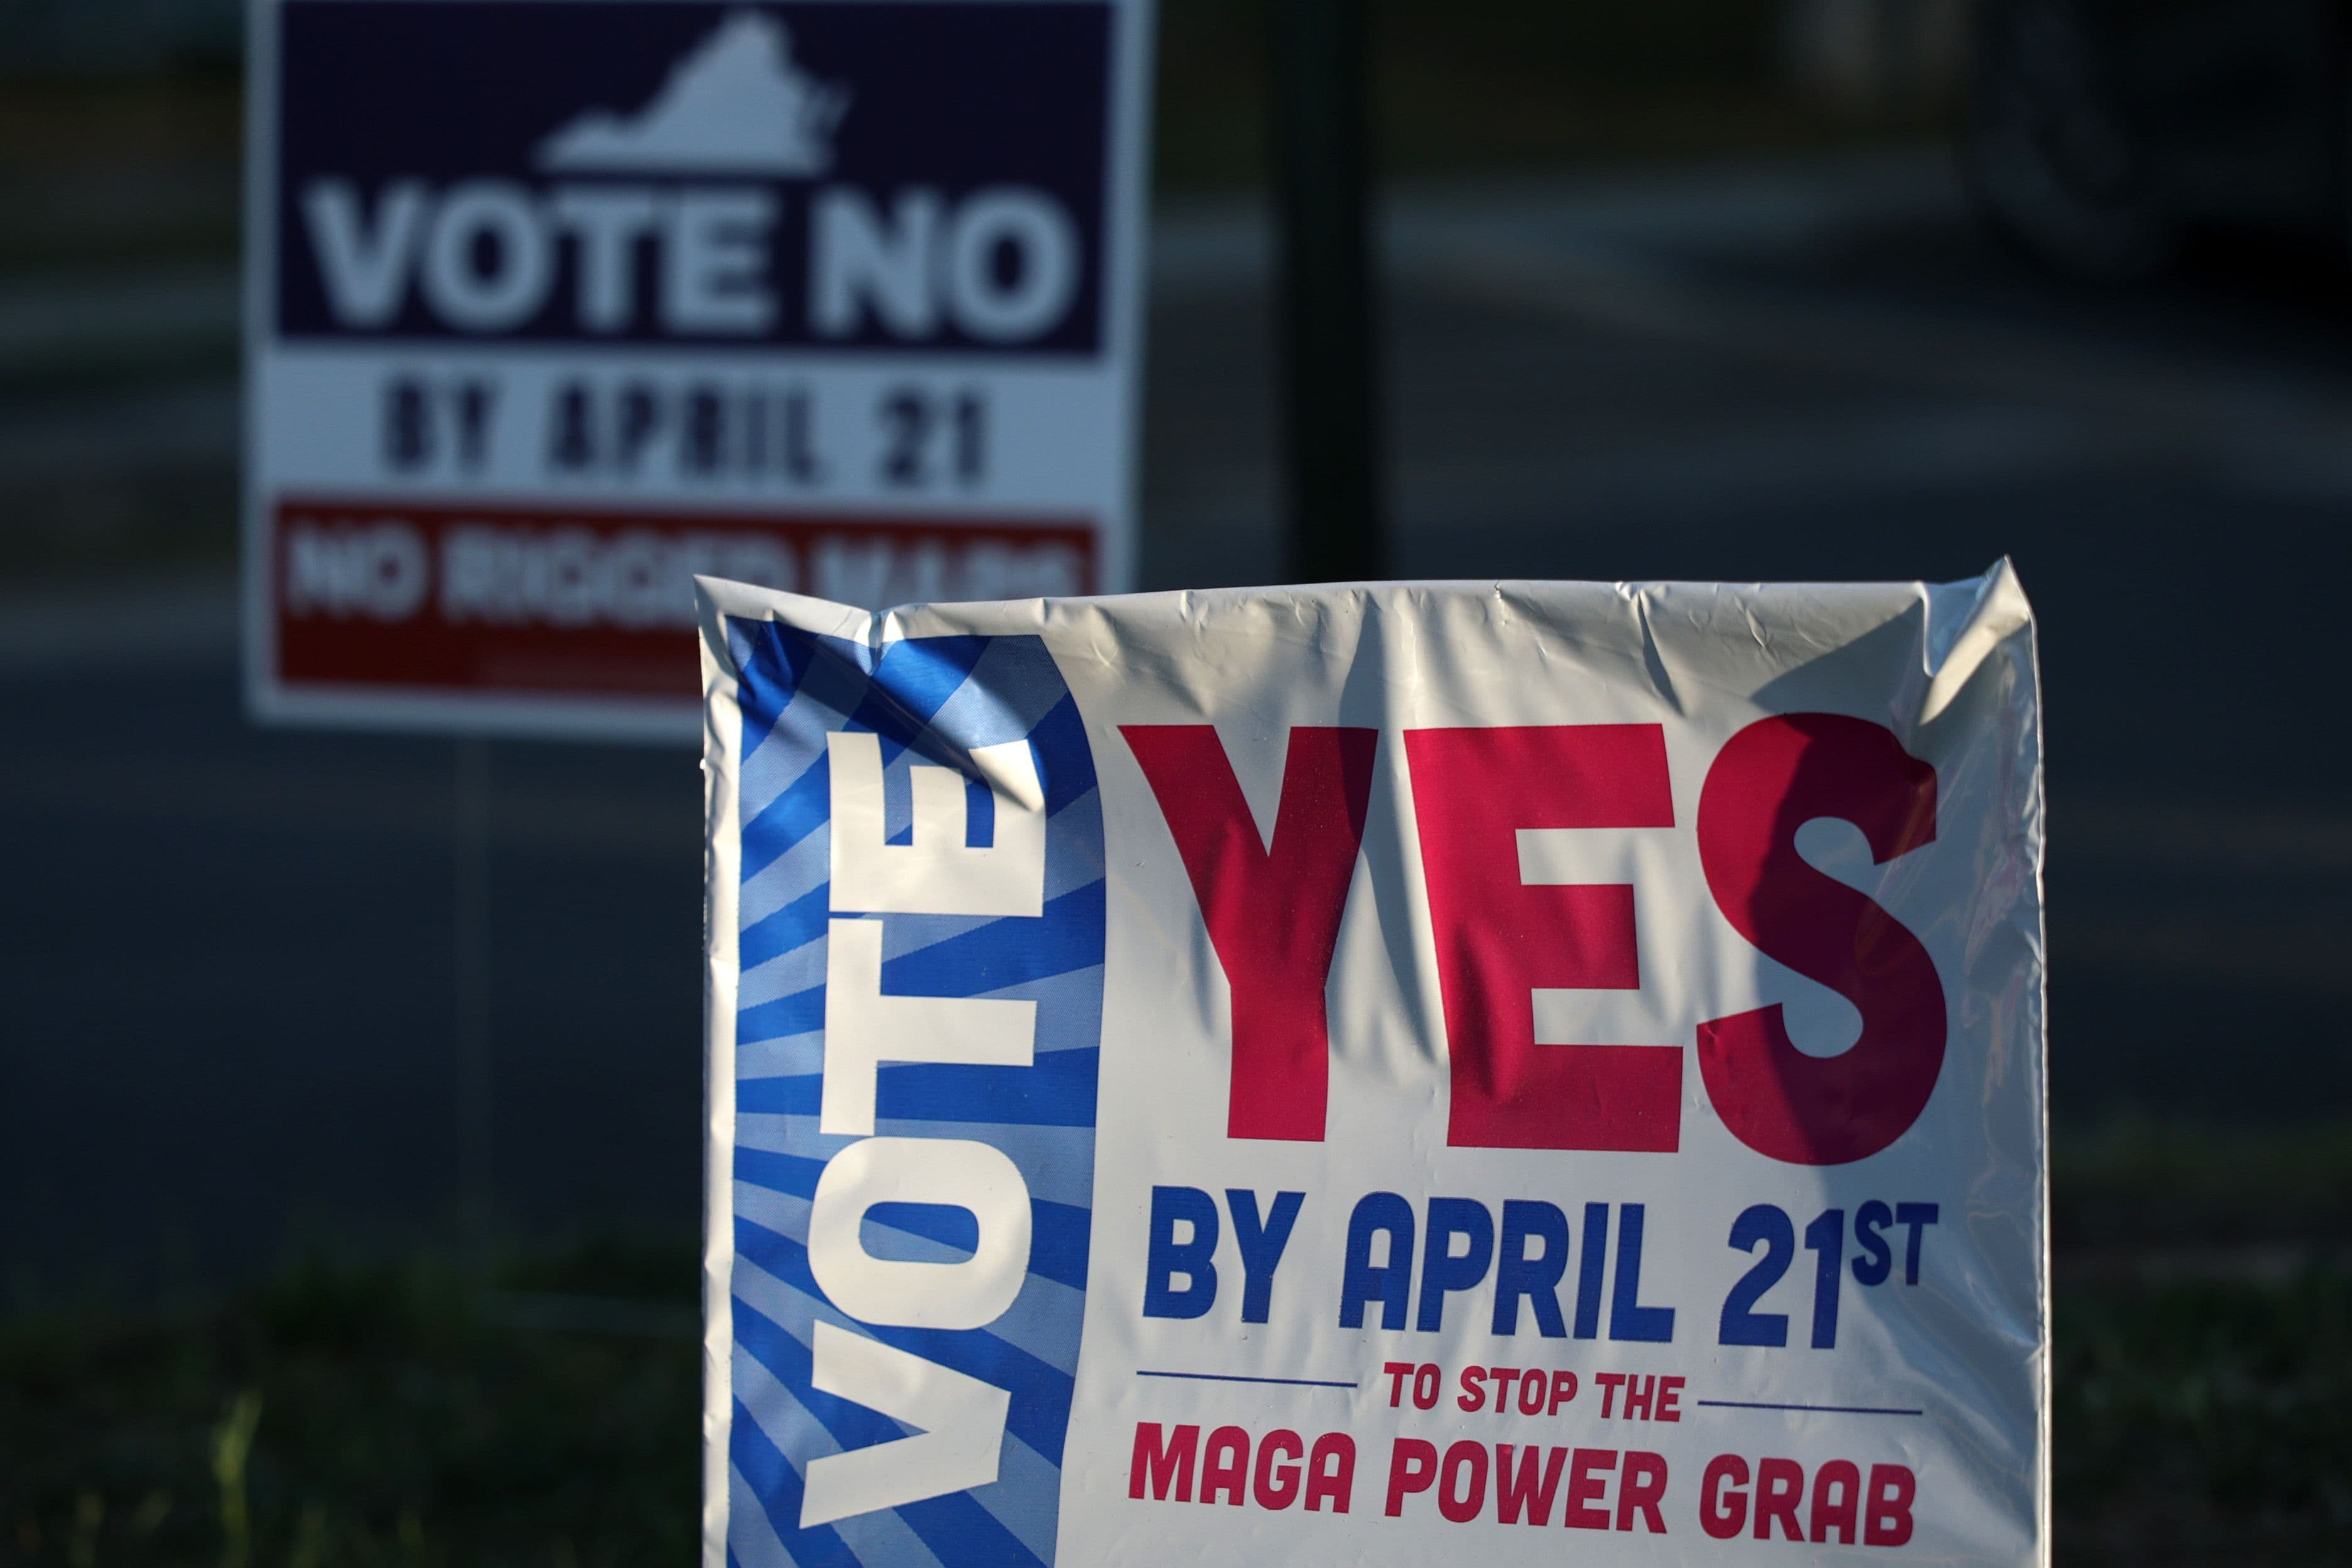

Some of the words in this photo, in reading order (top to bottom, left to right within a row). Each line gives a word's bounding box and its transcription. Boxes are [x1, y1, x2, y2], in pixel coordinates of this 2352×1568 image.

[303, 178, 776, 333] VOTE
[809, 187, 1079, 342] NO
[382, 377, 496, 475] BY
[545, 382, 824, 487] APRIL
[876, 391, 993, 489] 21
[286, 523, 430, 619] NO
[438, 526, 797, 628] RIGGED
[1118, 714, 1946, 1165] YES
[799, 732, 1047, 1529] VOTE
[1143, 1185, 1305, 1324] BY
[1339, 1192, 1675, 1342] APRIL
[1719, 1199, 1939, 1349] 21ST
[1383, 1362, 1440, 1410] TO
[1457, 1365, 1578, 1416] STOP
[1594, 1372, 1685, 1422] THE
[1129, 1422, 1357, 1514] MAGA
[1385, 1438, 1668, 1533] POWER
[1700, 1454, 1916, 1547] GRAB
